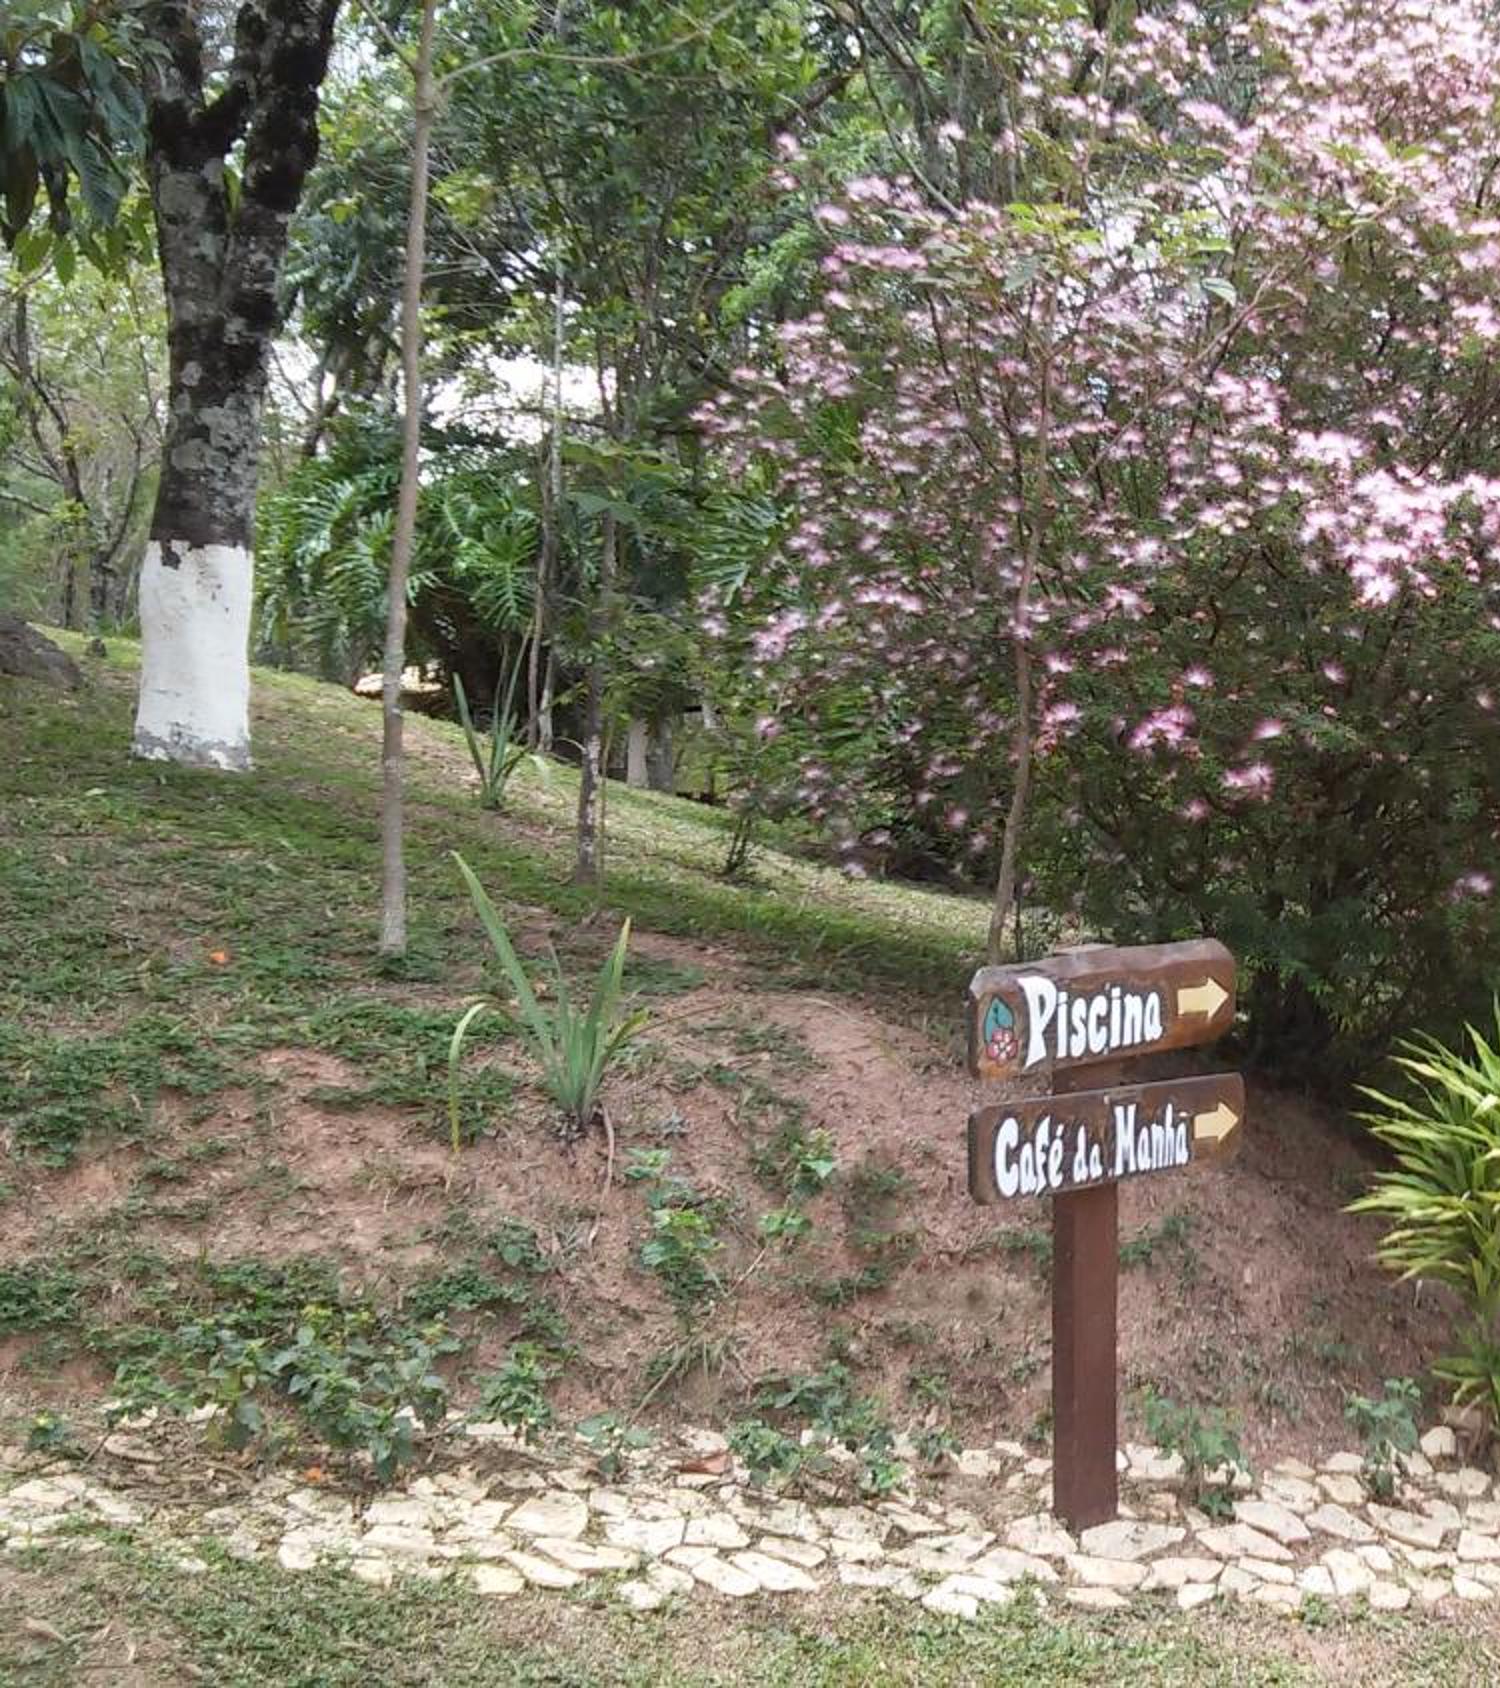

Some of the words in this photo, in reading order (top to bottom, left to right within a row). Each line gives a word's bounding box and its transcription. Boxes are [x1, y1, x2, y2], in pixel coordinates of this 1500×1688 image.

[1017, 975, 1164, 1070] Piscina
[995, 1114, 1064, 1197] Café
[1072, 1125, 1104, 1183] da
[1112, 1103, 1190, 1178] Manhã
